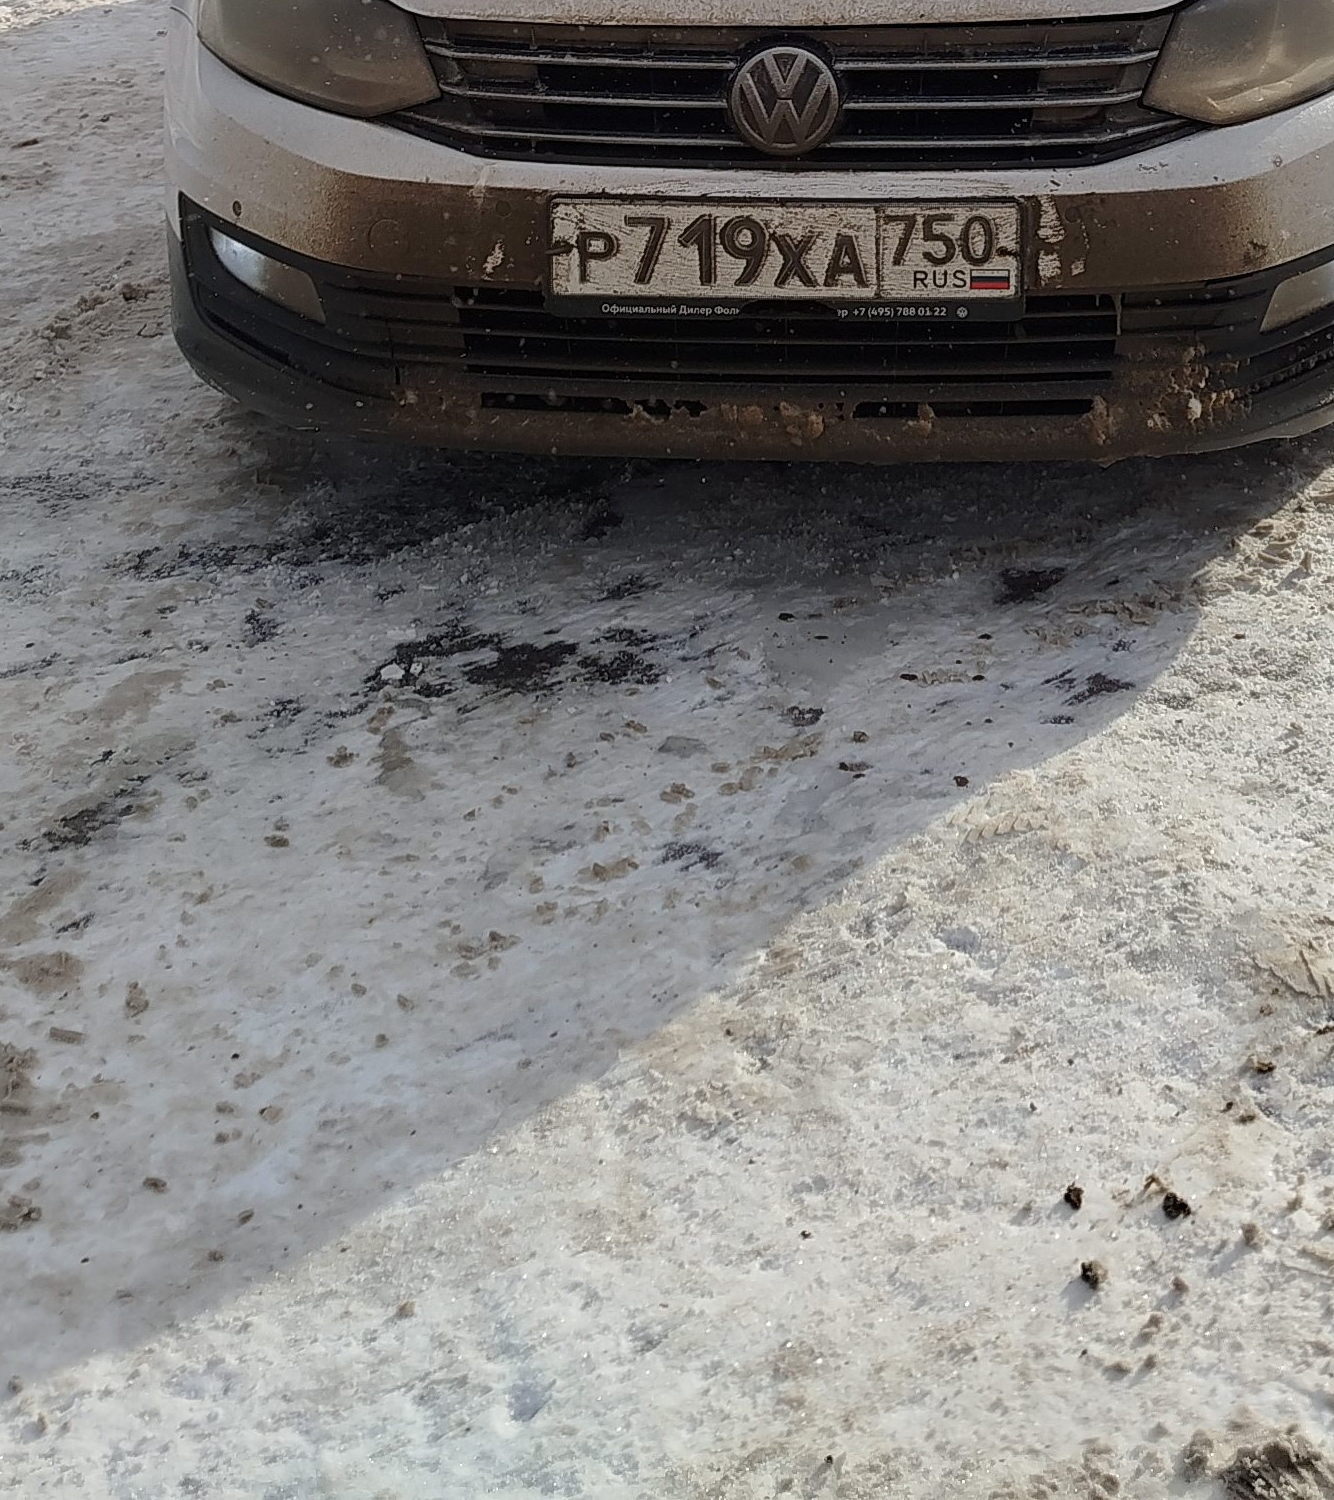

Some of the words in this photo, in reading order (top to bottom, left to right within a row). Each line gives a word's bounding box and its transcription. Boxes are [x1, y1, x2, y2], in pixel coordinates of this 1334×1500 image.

[883, 213, 995, 266] 750
[913, 269, 967, 289] RUS
[601, 303, 677, 315] Официальный
[679, 305, 712, 317] Дилер
[852, 307, 866, 317] +7
[868, 306, 894, 319] (495)
[896, 307, 916, 317] 788
[933, 307, 947, 317] 22
